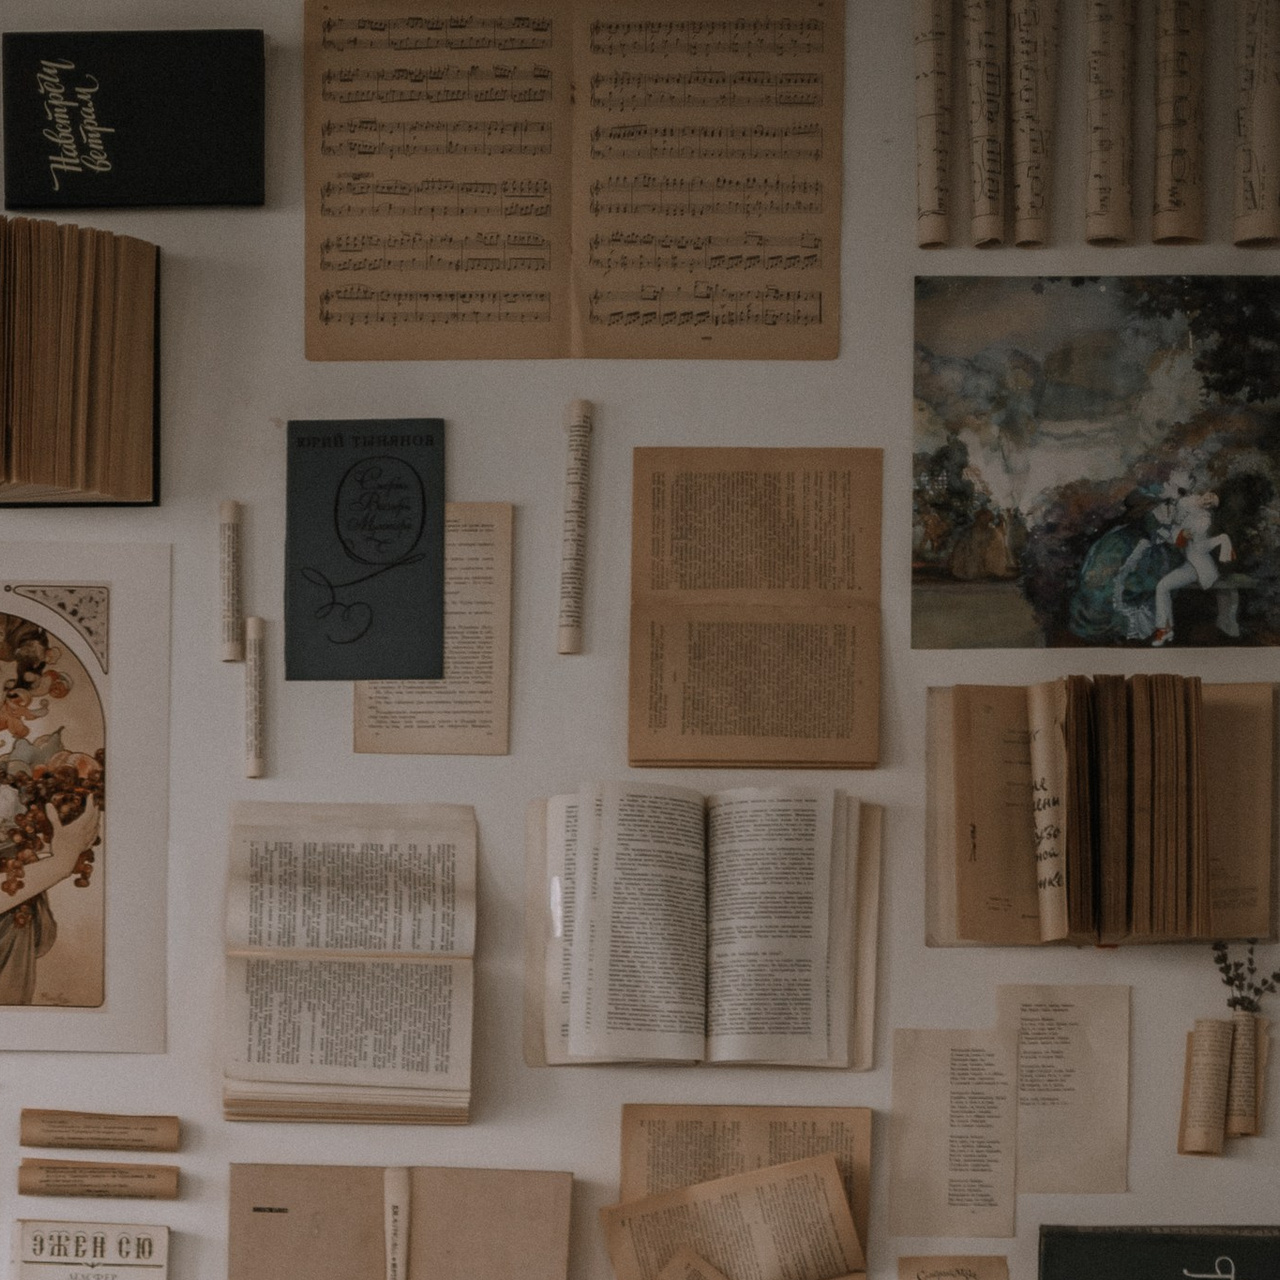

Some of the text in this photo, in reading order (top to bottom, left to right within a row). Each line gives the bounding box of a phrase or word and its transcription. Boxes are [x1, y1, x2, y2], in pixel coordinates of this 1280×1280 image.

[75, 74, 116, 173] ветрам
[297, 432, 435, 448] ЮРИЙ ТЫНЯНОВ
[32, 1229, 154, 1260] ЭЖЕН СЮ
